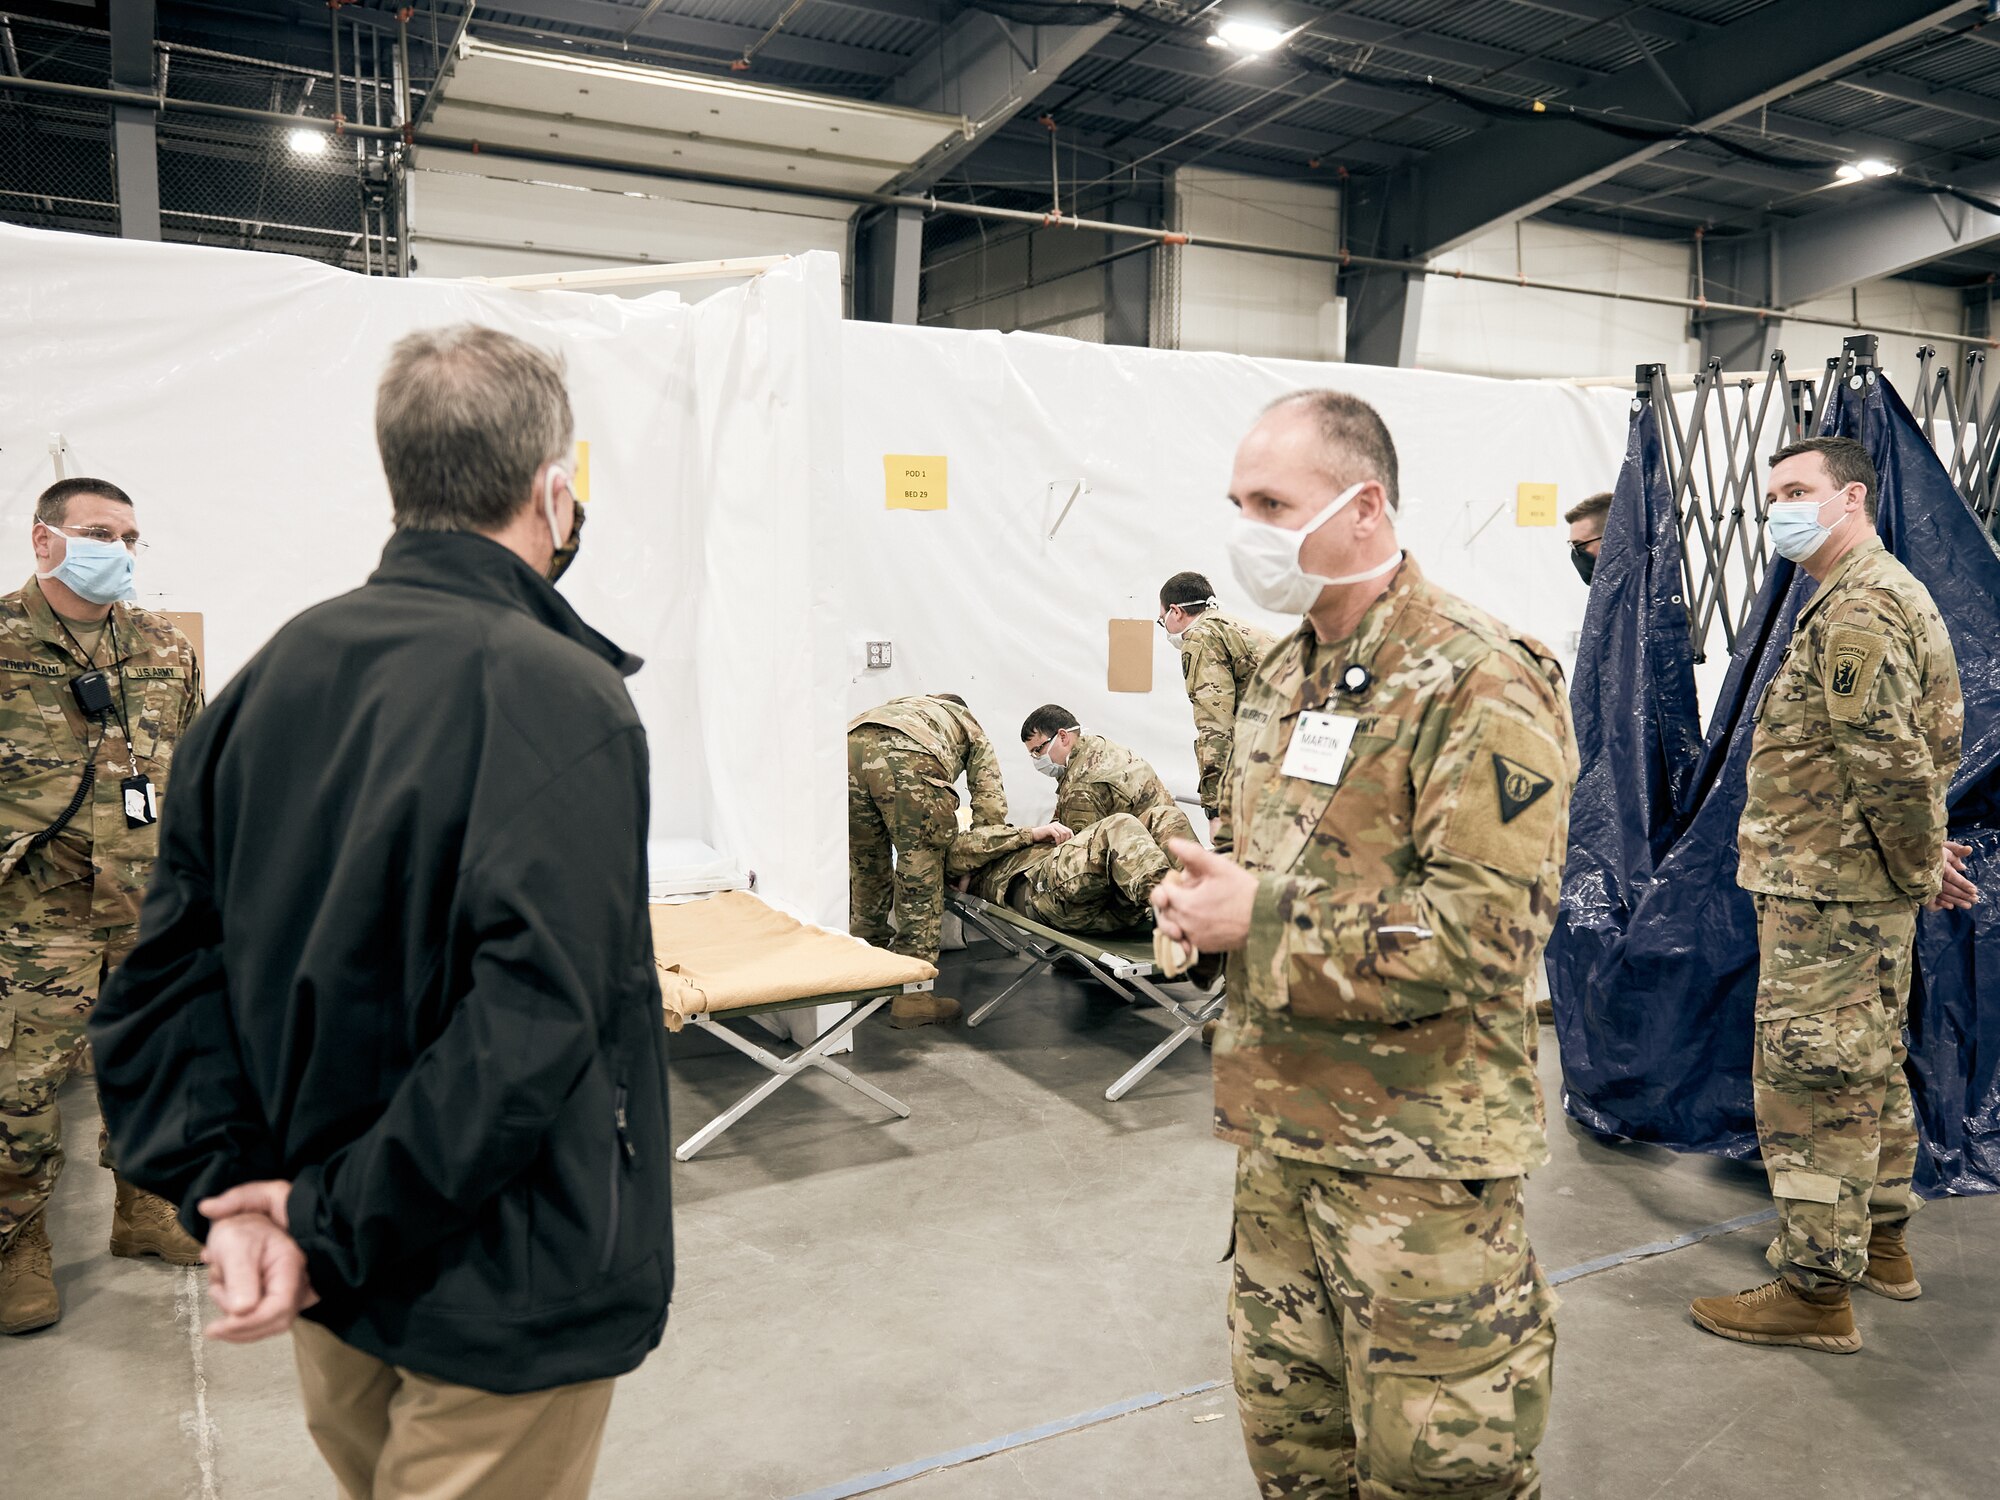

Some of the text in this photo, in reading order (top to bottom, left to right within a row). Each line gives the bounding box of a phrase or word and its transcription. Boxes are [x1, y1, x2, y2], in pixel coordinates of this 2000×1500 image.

[904, 490, 918, 498] BED
[1838, 646, 1866, 656] MOUNTAIN
[3, 660, 60, 675] TREVISANI
[152, 667, 174, 677] ARMY
[1301, 733, 1338, 749] MARTIN
